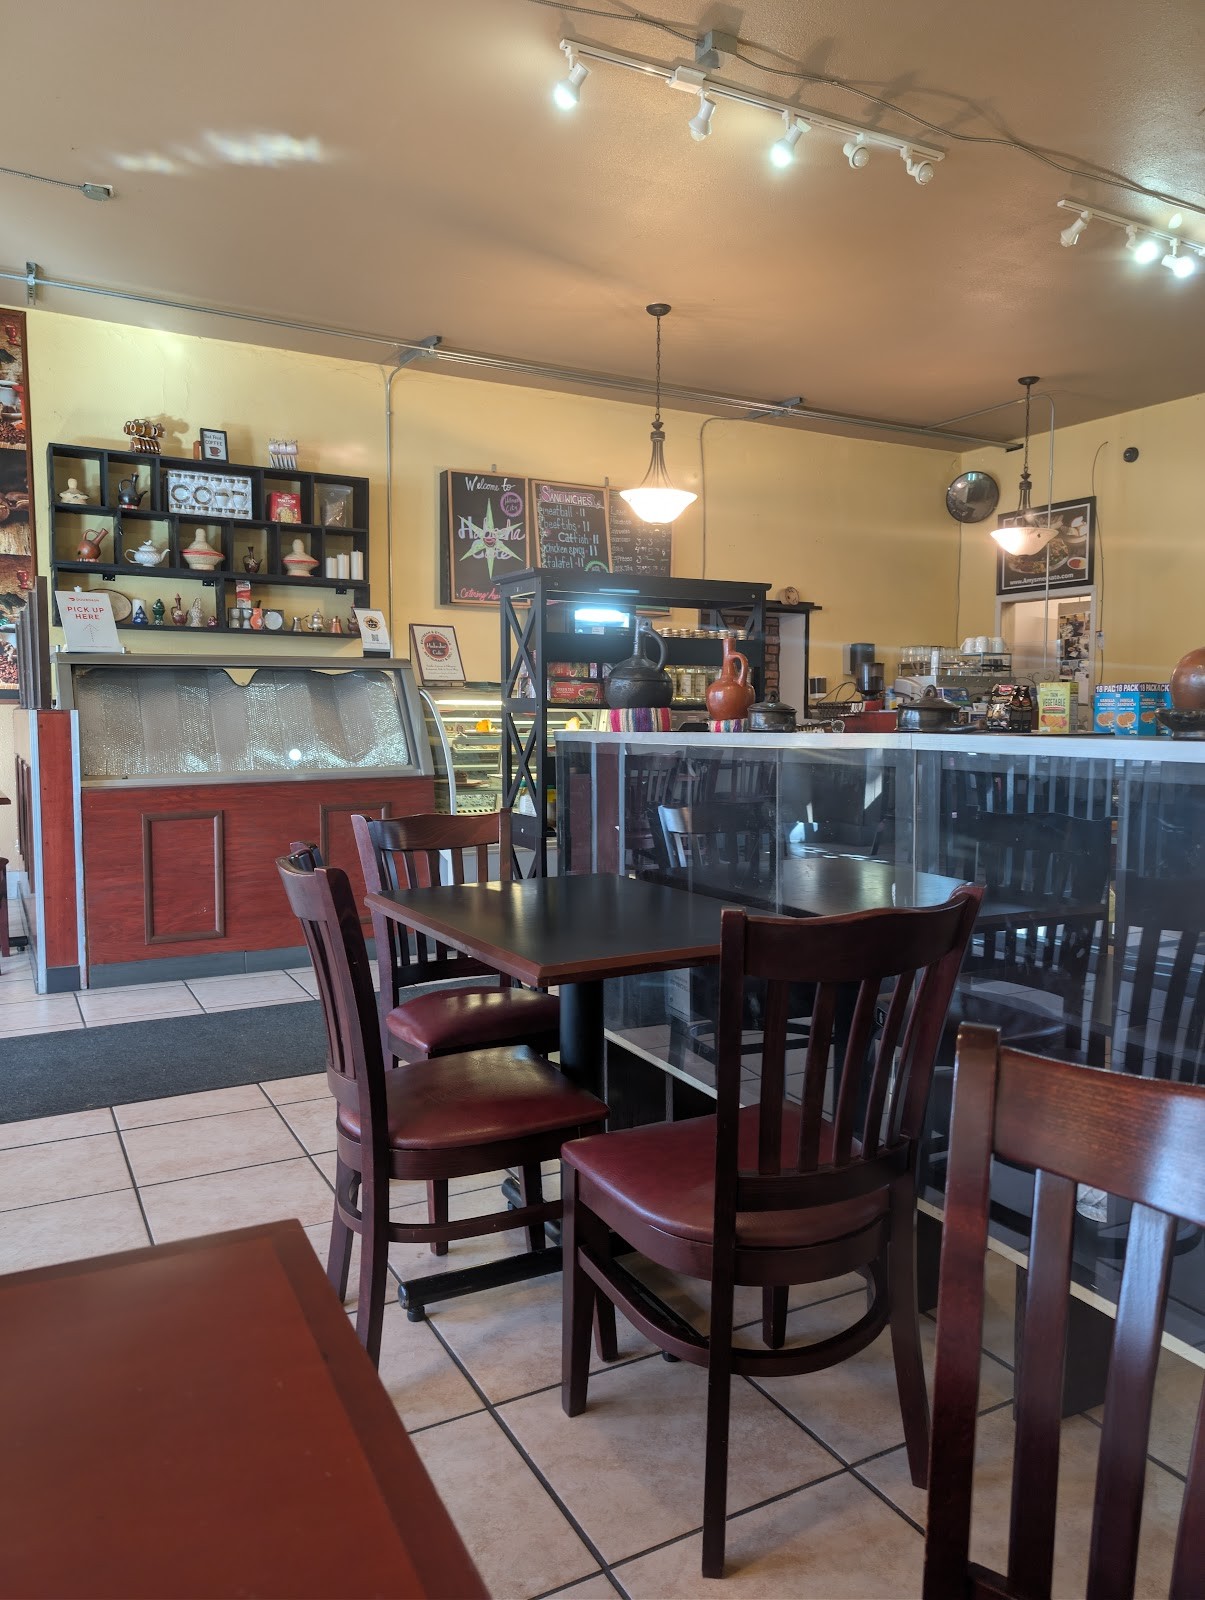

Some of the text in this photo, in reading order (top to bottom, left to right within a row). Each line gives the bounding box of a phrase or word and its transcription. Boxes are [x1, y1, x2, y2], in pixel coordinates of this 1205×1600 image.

[465, 476, 516, 492] Welcome to
[541, 485, 593, 506] SANDWICHES
[542, 504, 573, 518] meatball
[543, 519, 561, 531] beef
[545, 543, 567, 554] chicken
[568, 546, 586, 559] spicy
[547, 556, 573, 569] falafel
[1096, 685, 1116, 693] 18 PAC
[1116, 684, 1139, 692] 18 PACK
[1146, 684, 1157, 692] PACK
[1042, 698, 1066, 707] VEGETABLE
